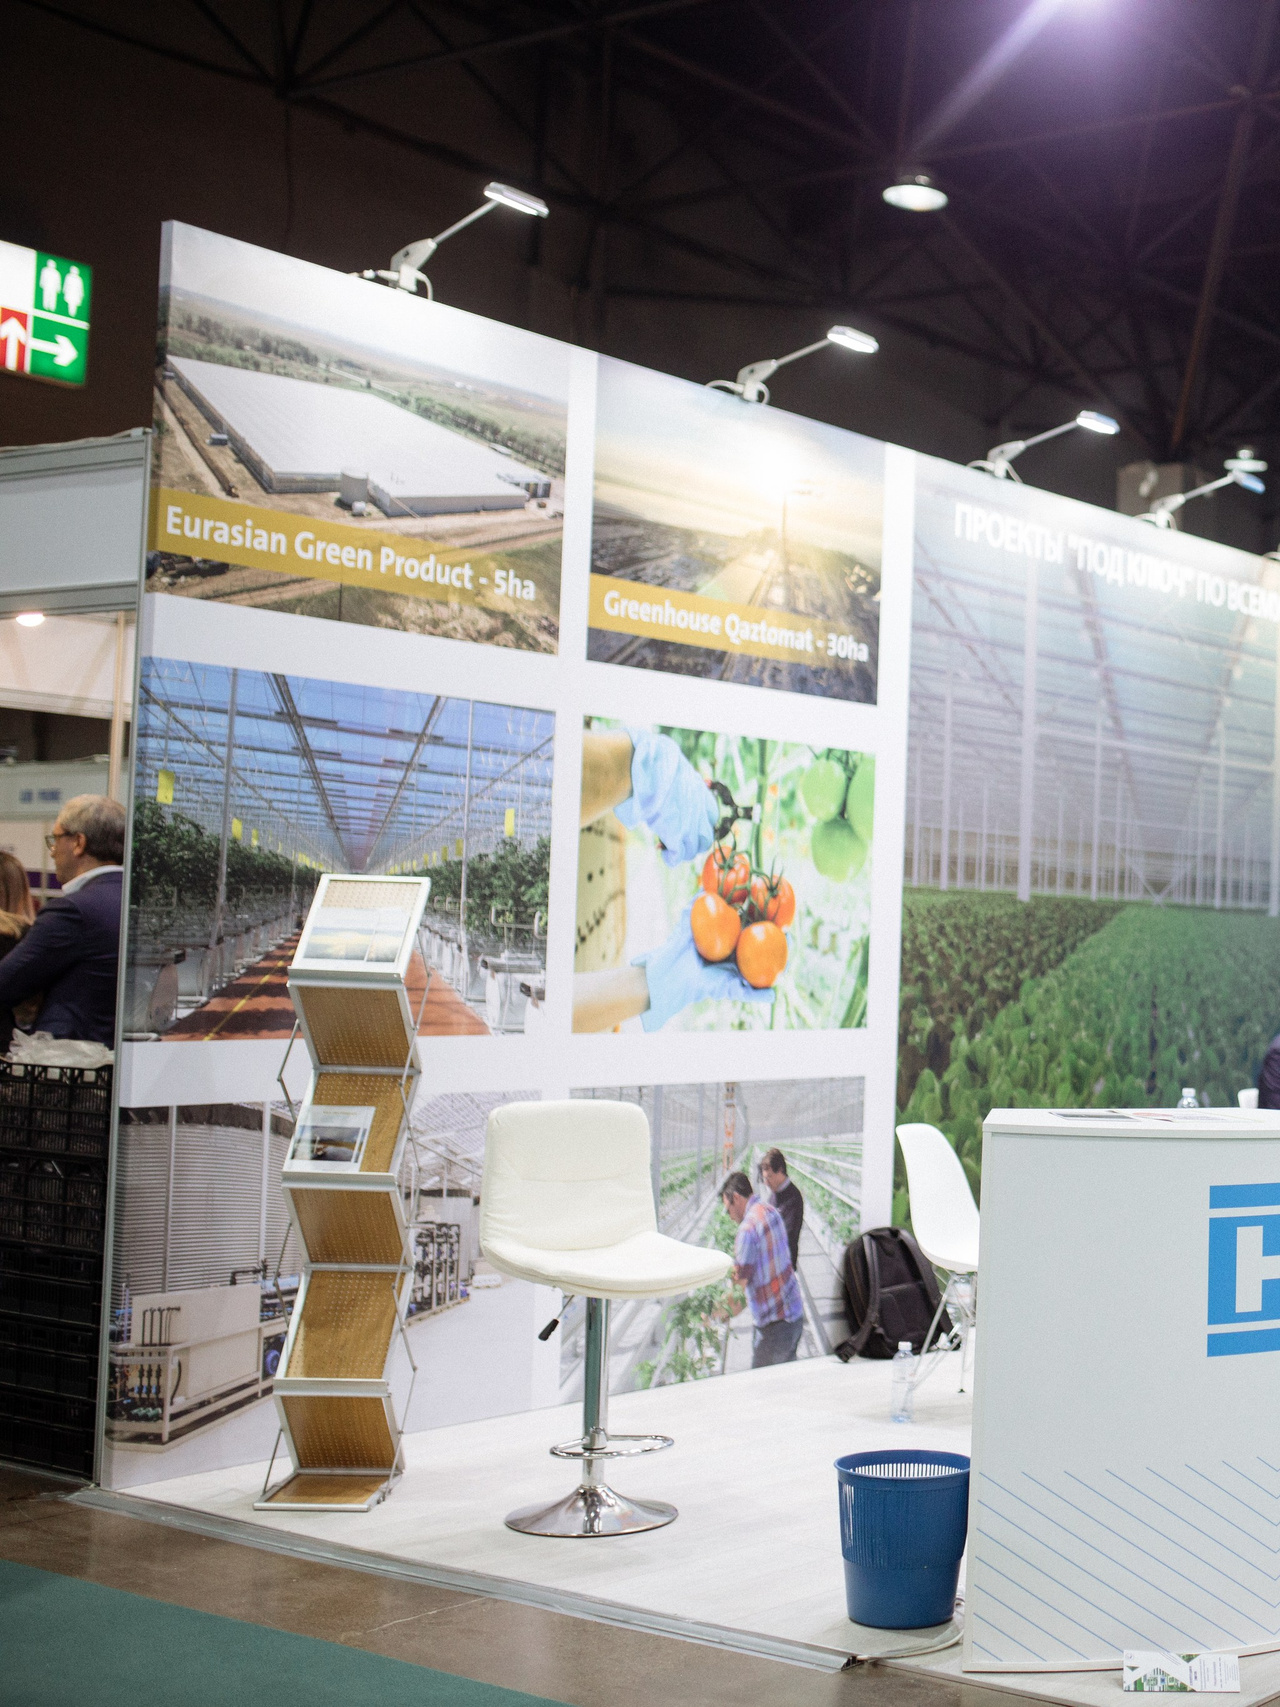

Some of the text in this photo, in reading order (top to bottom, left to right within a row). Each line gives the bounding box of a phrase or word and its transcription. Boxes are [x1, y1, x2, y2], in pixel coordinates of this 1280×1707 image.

[166, 505, 287, 555] Eurasian
[294, 531, 373, 571] Green
[380, 546, 474, 590] Product
[494, 568, 536, 601] 5ha
[954, 501, 1064, 565] ПРОЕКТЫ
[1196, 571, 1225, 607] ПО
[604, 590, 721, 635] Greenhouse
[725, 613, 813, 653] Qaztomat
[827, 632, 869, 662] 30ha
